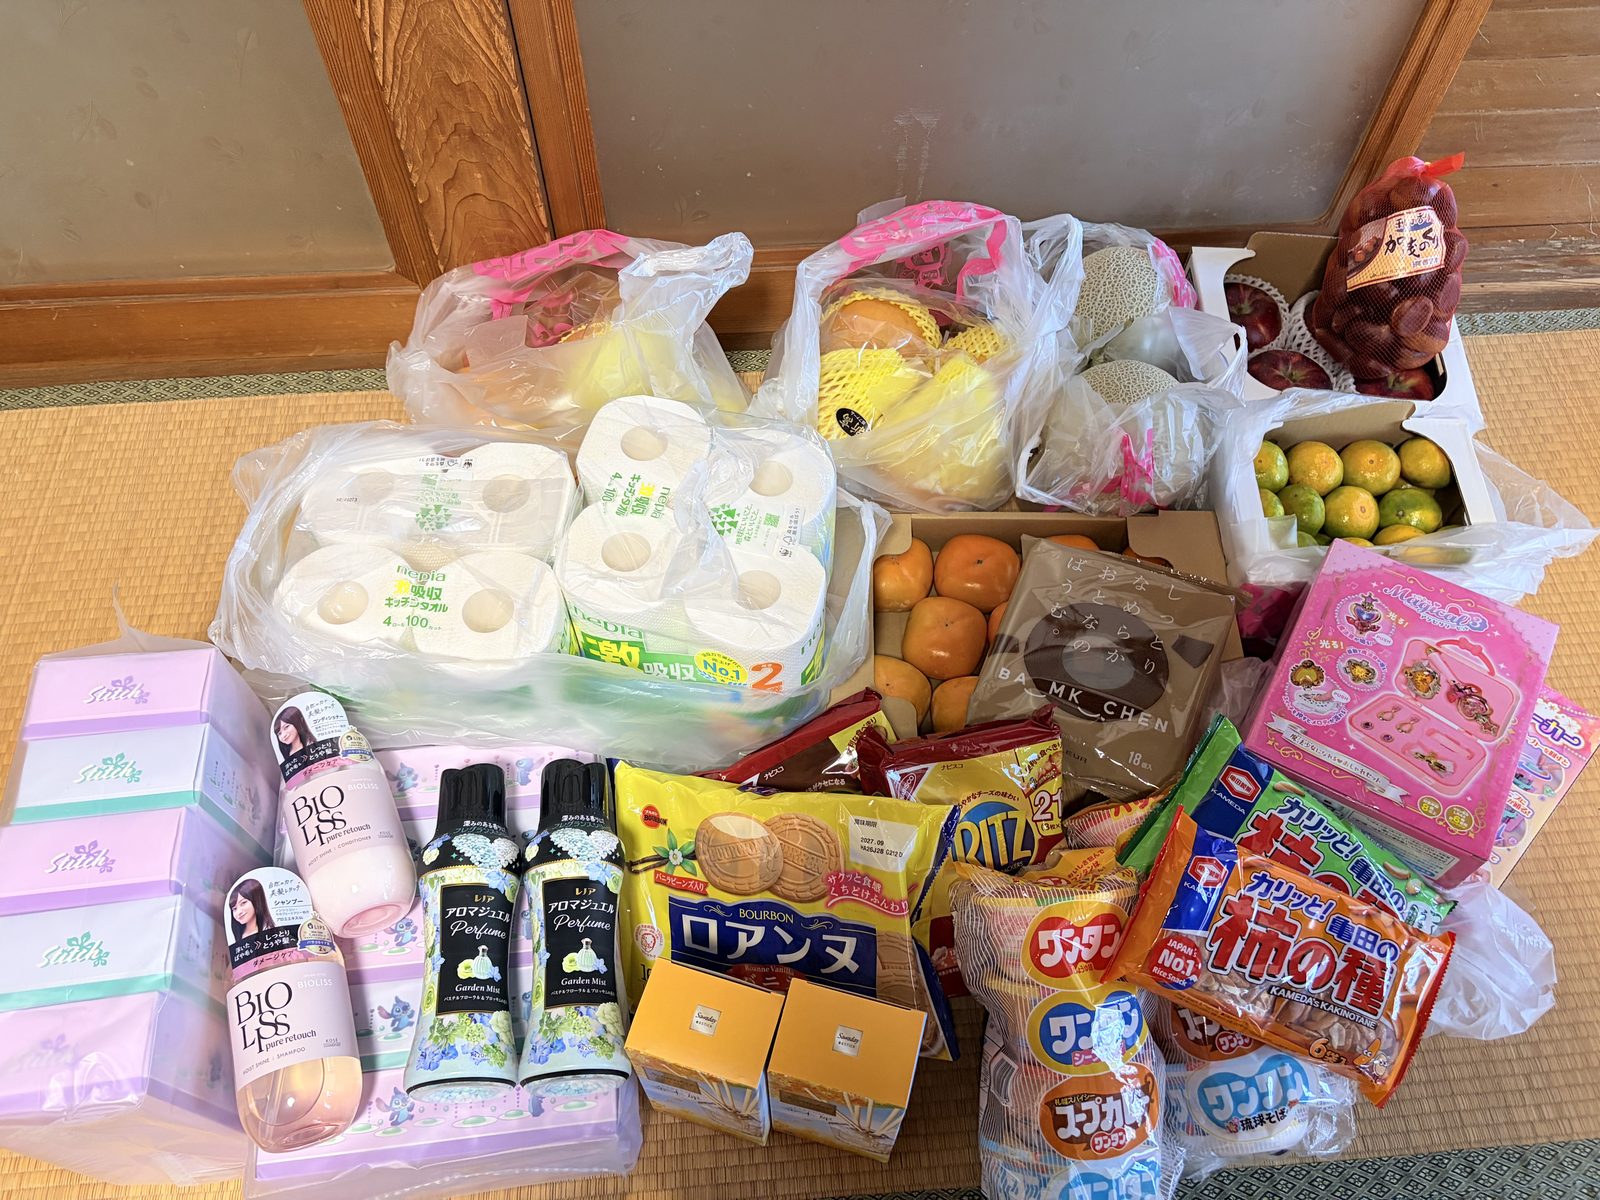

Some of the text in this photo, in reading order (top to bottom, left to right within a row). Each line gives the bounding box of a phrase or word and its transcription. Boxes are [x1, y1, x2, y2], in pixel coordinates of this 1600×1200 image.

[650, 486, 671, 519] nepia
[396, 565, 446, 581] nepia
[384, 596, 449, 613] キッチンタオル
[1319, 638, 1345, 650] 光る!
[703, 659, 741, 681] No.1
[83, 682, 145, 705] Stitch
[74, 760, 137, 784] Stitch
[763, 766, 785, 780] ナビスコ
[941, 763, 964, 771] ナビスコ
[1210, 788, 1246, 816] KAMEDA
[326, 831, 343, 844] pure
[343, 823, 371, 836] retouch
[1277, 796, 1362, 860] カリッと!
[860, 837, 885, 846] 2027.09
[956, 811, 1031, 868] RITZ
[45, 848, 110, 874] Stitch
[574, 887, 596, 896] レノア
[655, 872, 705, 892] バニラビーンズ入り
[827, 873, 882, 894] サクッと食感
[274, 898, 303, 906] シャンプー
[474, 894, 495, 903] レノア
[829, 884, 911, 915] くちどけふんわり
[1248, 871, 1332, 921] カリッと!
[445, 906, 512, 923] アロマジュエル
[548, 899, 615, 915] アロマジュエル
[738, 908, 795, 925] BOURBON
[449, 919, 507, 940] Perfume
[553, 914, 611, 932] Perfume
[265, 929, 290, 941] しっとり
[681, 913, 862, 975] ロアンヌ
[1326, 914, 1400, 962] 亀田の
[36, 940, 104, 969] Stitch
[1038, 924, 1121, 968] ワンタン
[1208, 895, 1397, 1016] 柿の種
[252, 950, 294, 967] ダメージケア
[1157, 948, 1196, 977] No.1
[297, 978, 333, 989] BIOLISS
[560, 977, 607, 986] Garden Mist
[1152, 966, 1188, 987] Rice Snack
[455, 983, 501, 994] Garden Mist
[1319, 1000, 1377, 1030] KAKINOTANE
[1048, 1001, 1140, 1055] ワンン
[265, 1029, 317, 1052] pure retouch
[255, 1057, 270, 1068] SHINE
[276, 1046, 306, 1059] SHAMPOO
[1203, 1063, 1304, 1122] ワンタン
[1055, 1096, 1150, 1140] スープカレ
[1093, 1130, 1127, 1152] ワンタン
